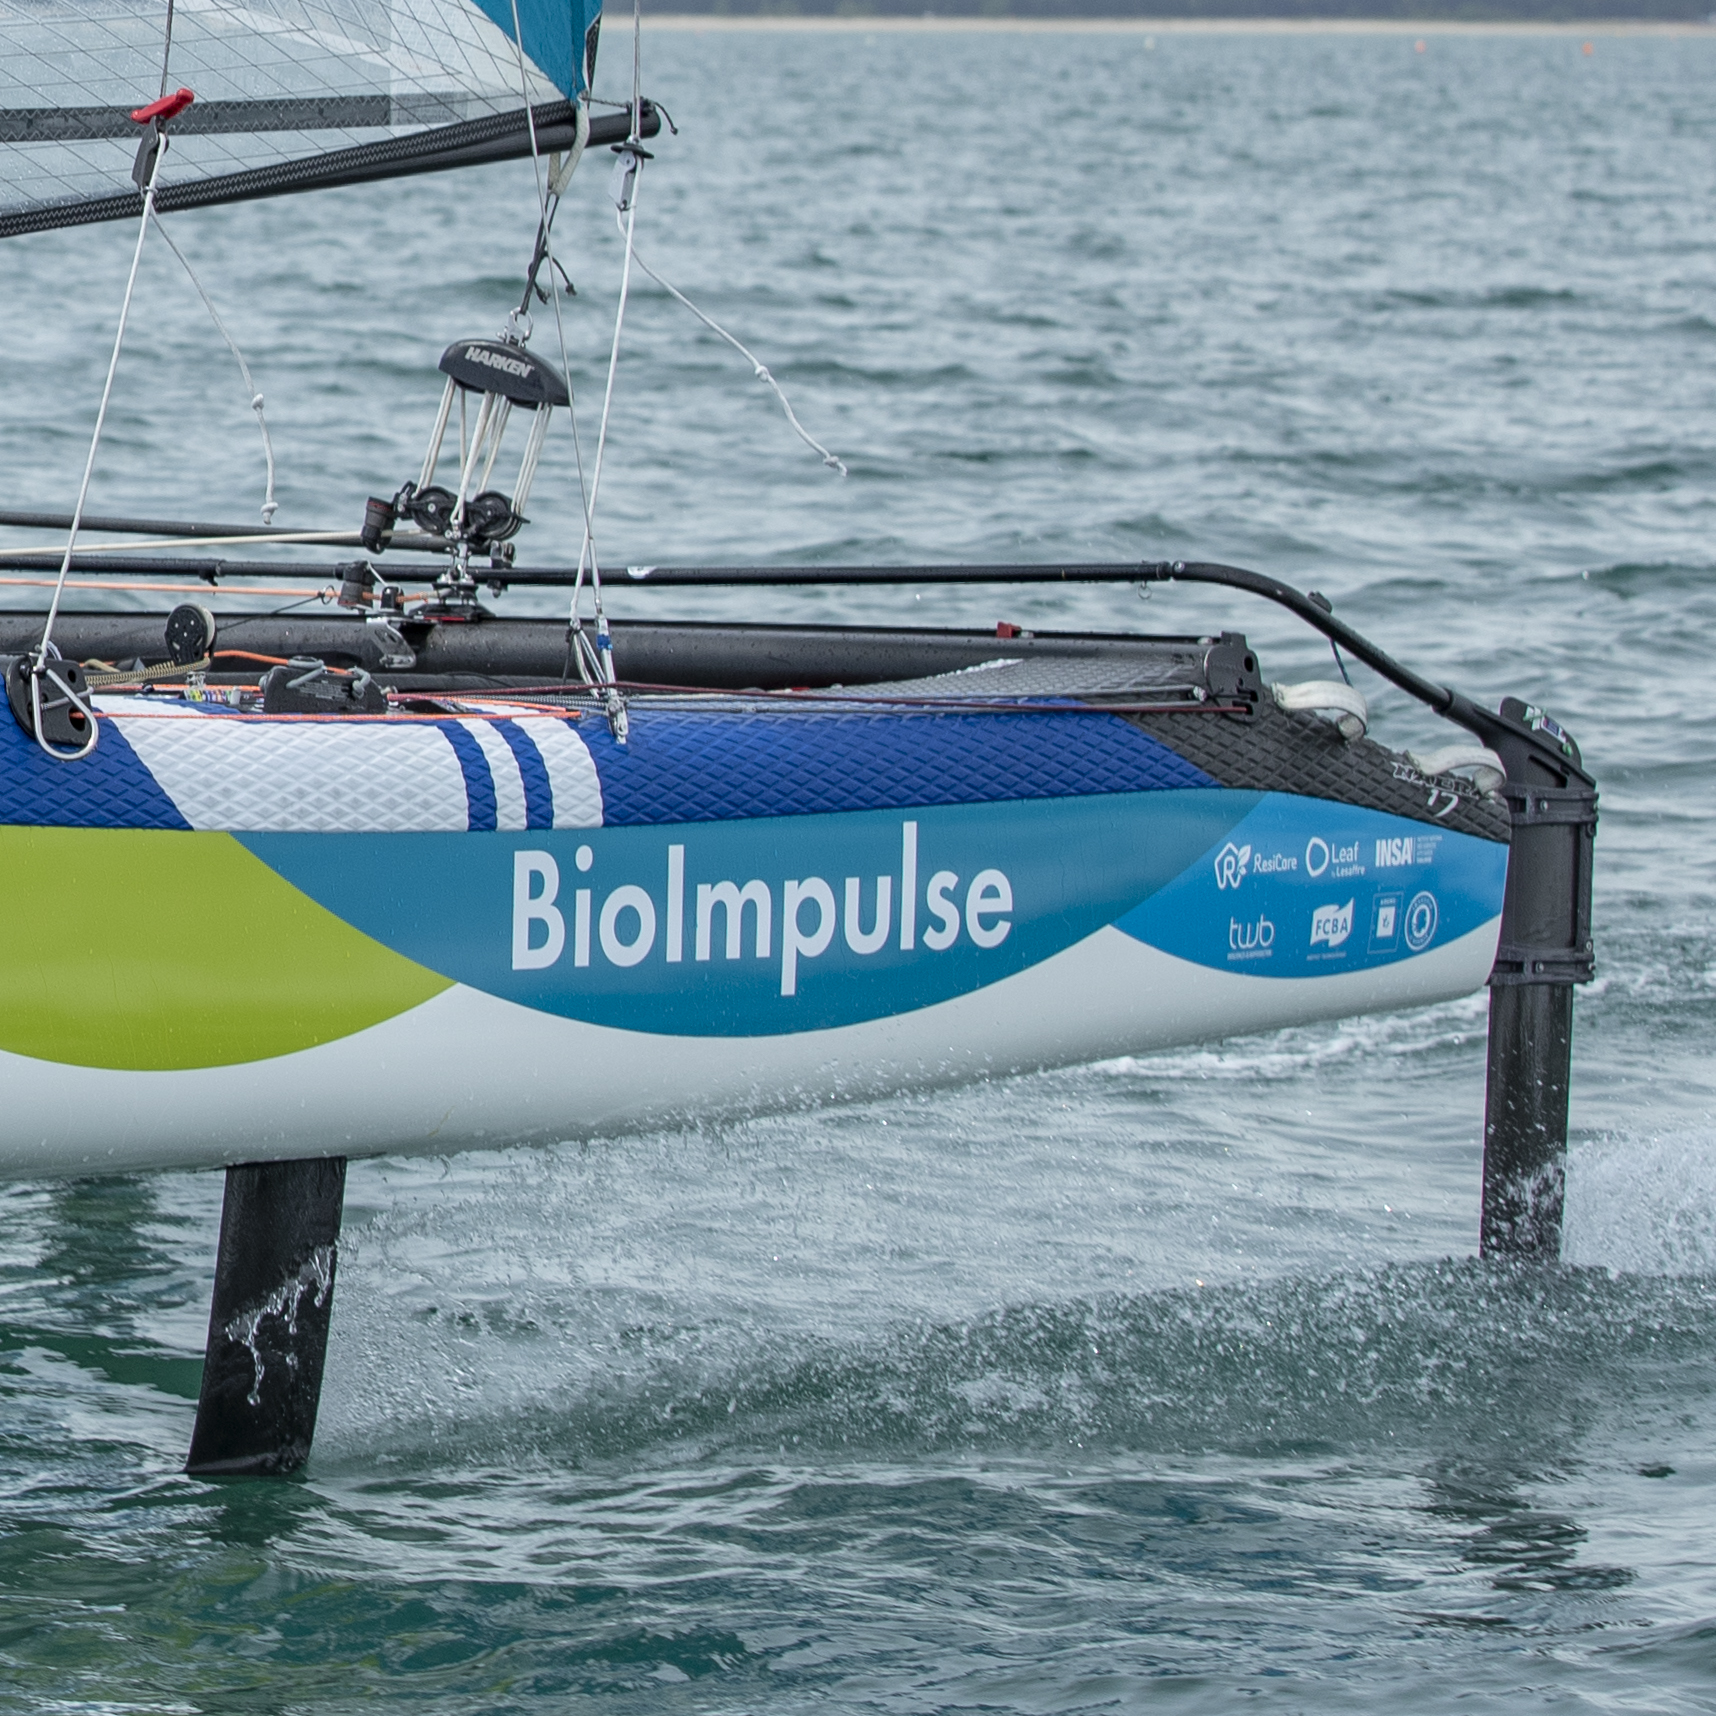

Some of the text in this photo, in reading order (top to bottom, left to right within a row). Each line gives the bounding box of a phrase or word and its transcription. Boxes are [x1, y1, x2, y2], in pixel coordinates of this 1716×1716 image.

[464, 345, 532, 379] HARKEN
[1426, 788, 1459, 818] 17
[1252, 852, 1298, 873] ResiCare
[1331, 840, 1360, 864] Leaf
[1375, 836, 1413, 868] INSA
[512, 820, 1013, 997] BioImpulse
[1229, 913, 1275, 950] twb
[1315, 917, 1349, 936] FCBA
